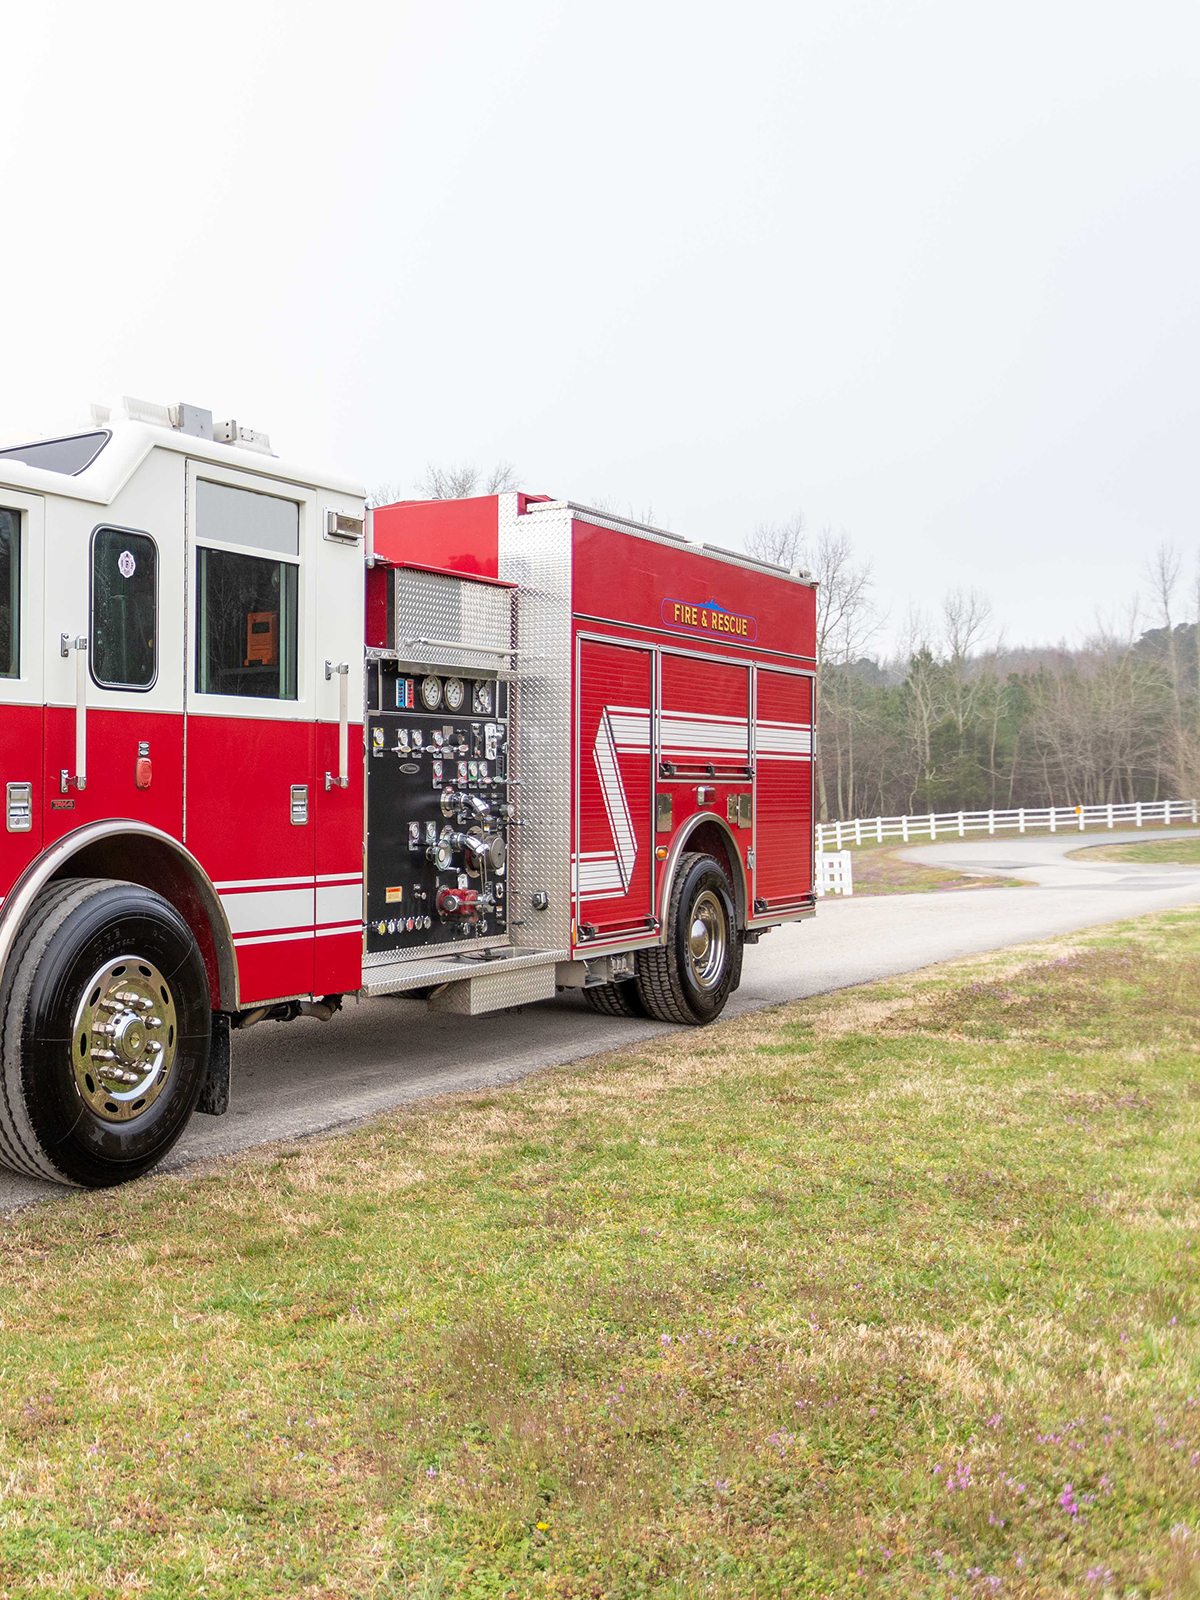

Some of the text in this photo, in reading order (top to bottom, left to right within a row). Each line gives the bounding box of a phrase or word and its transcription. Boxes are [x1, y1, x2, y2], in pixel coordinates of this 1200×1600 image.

[674, 603, 748, 636] FIRE & RESCUE
